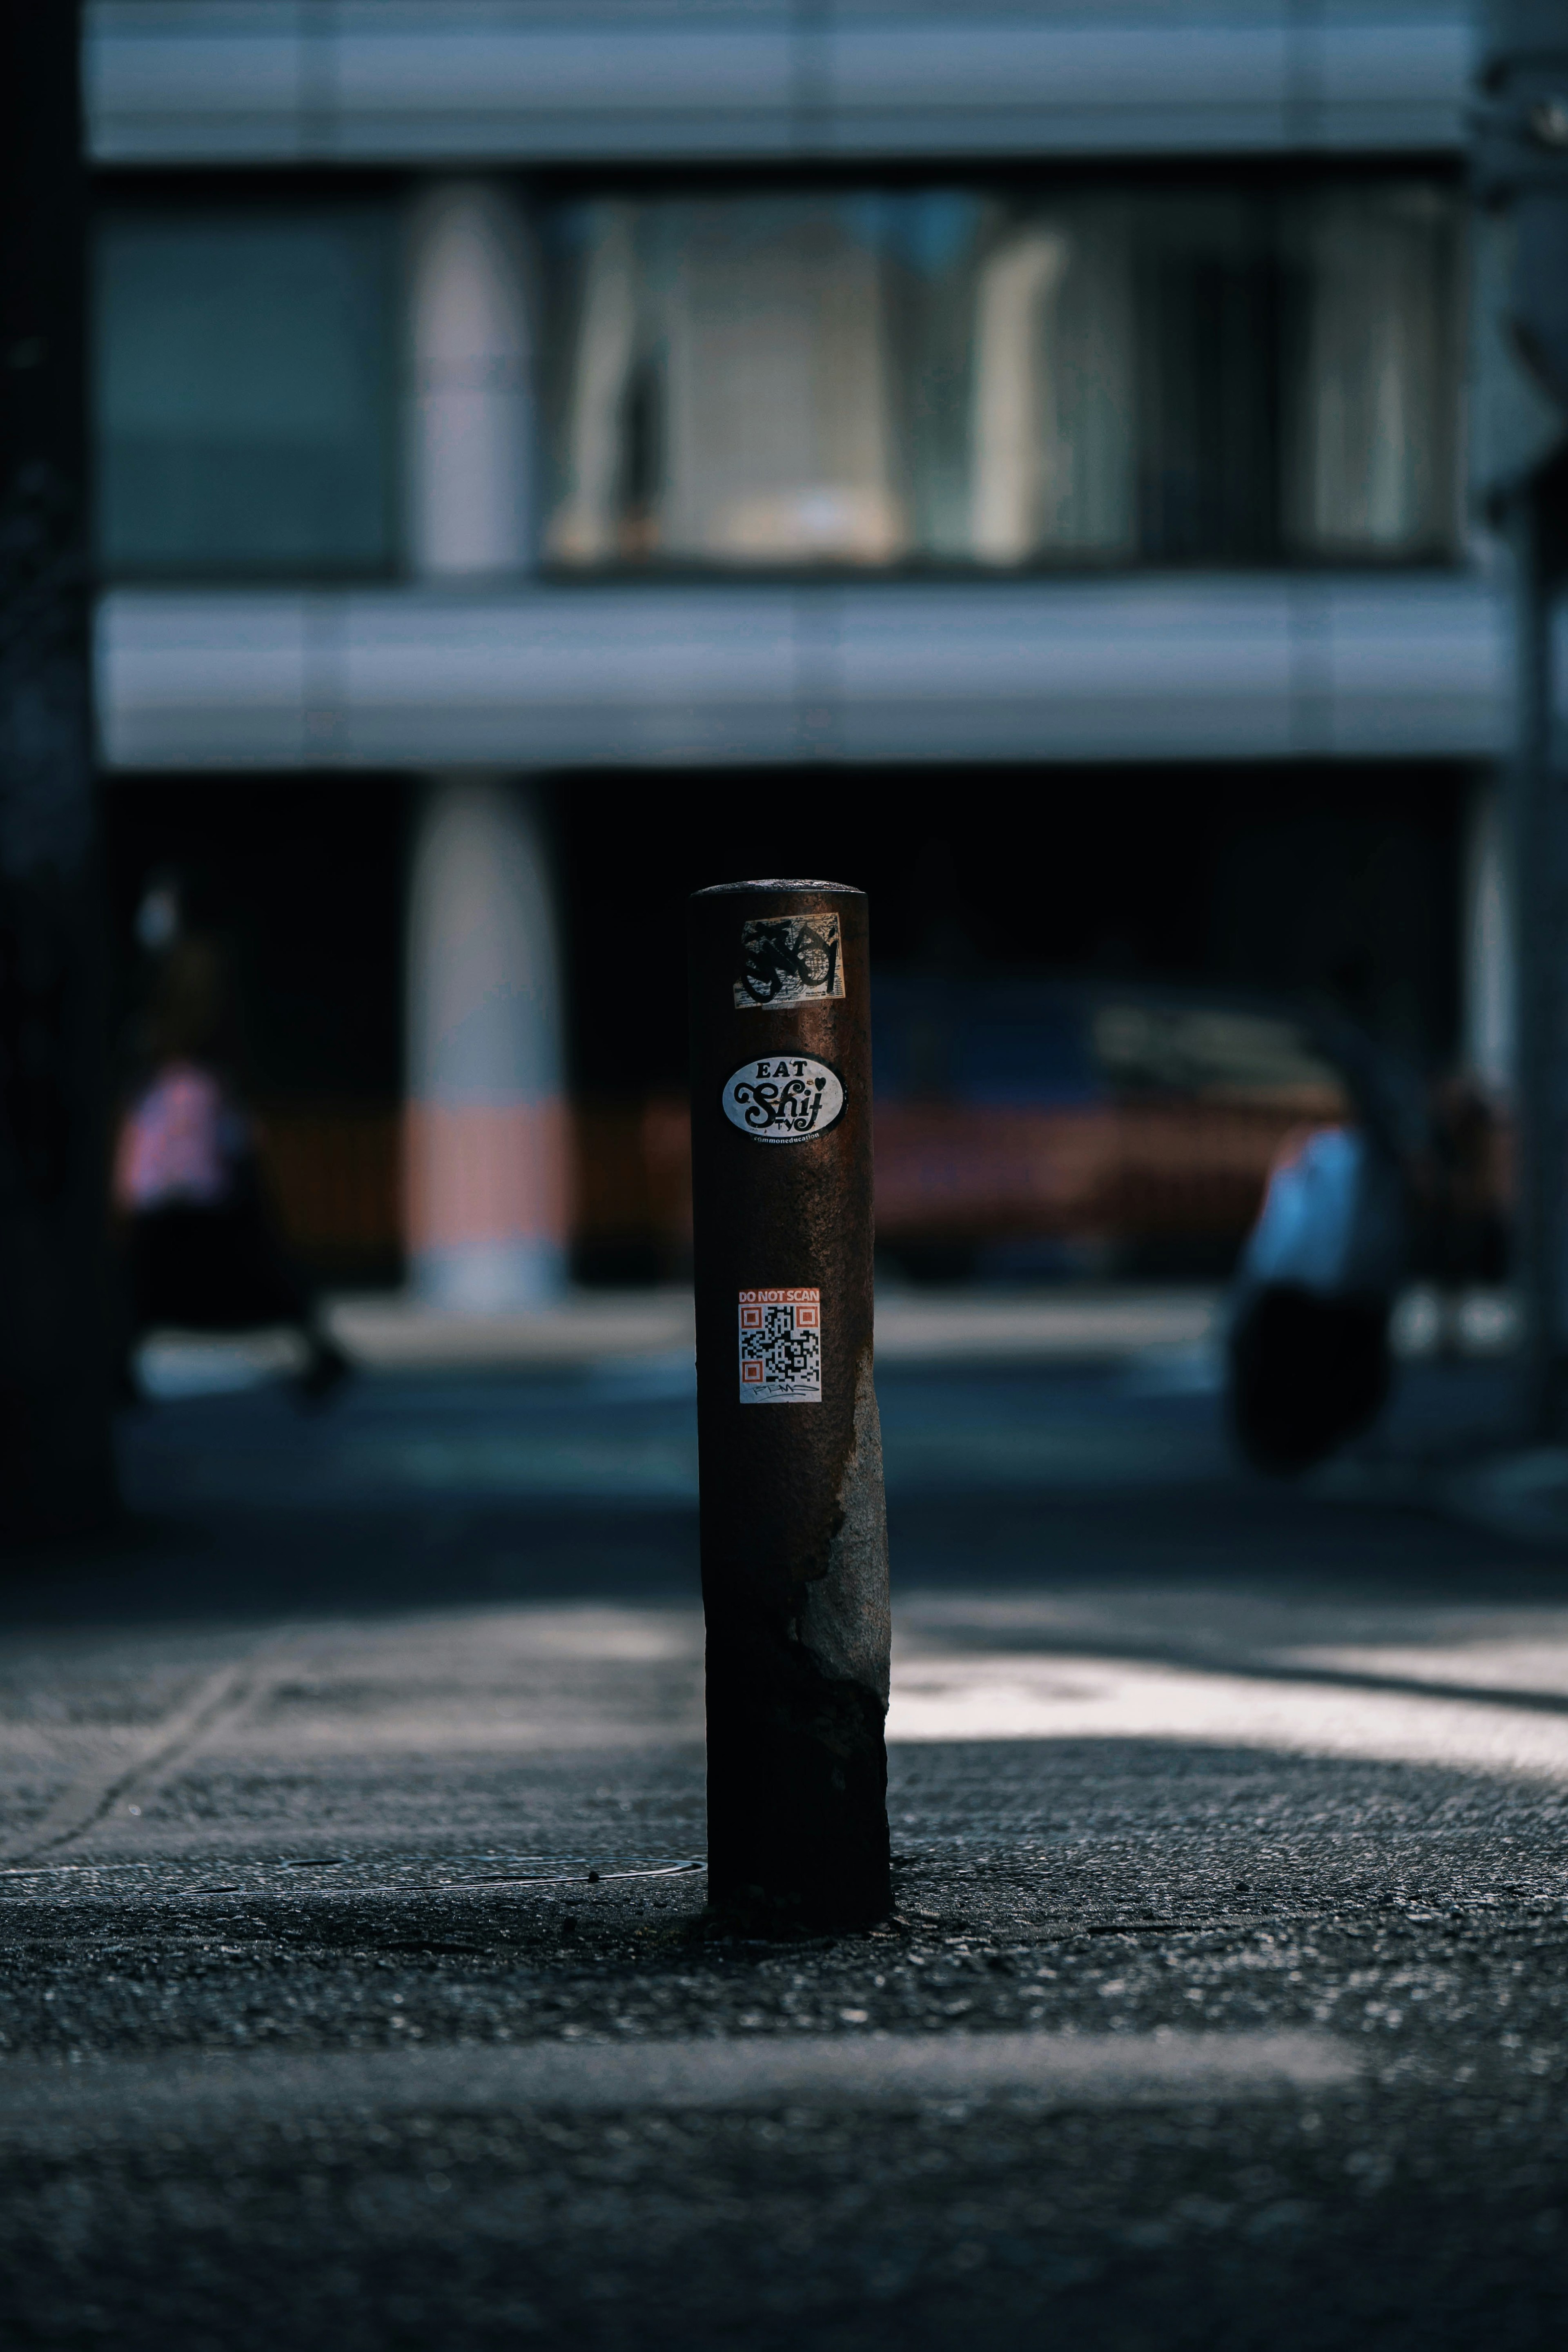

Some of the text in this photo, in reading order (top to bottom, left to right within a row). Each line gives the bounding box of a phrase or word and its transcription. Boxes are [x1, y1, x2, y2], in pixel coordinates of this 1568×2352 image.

[756, 1061, 807, 1078] EAT
[739, 1290, 819, 1302] DO NOT SCAN
